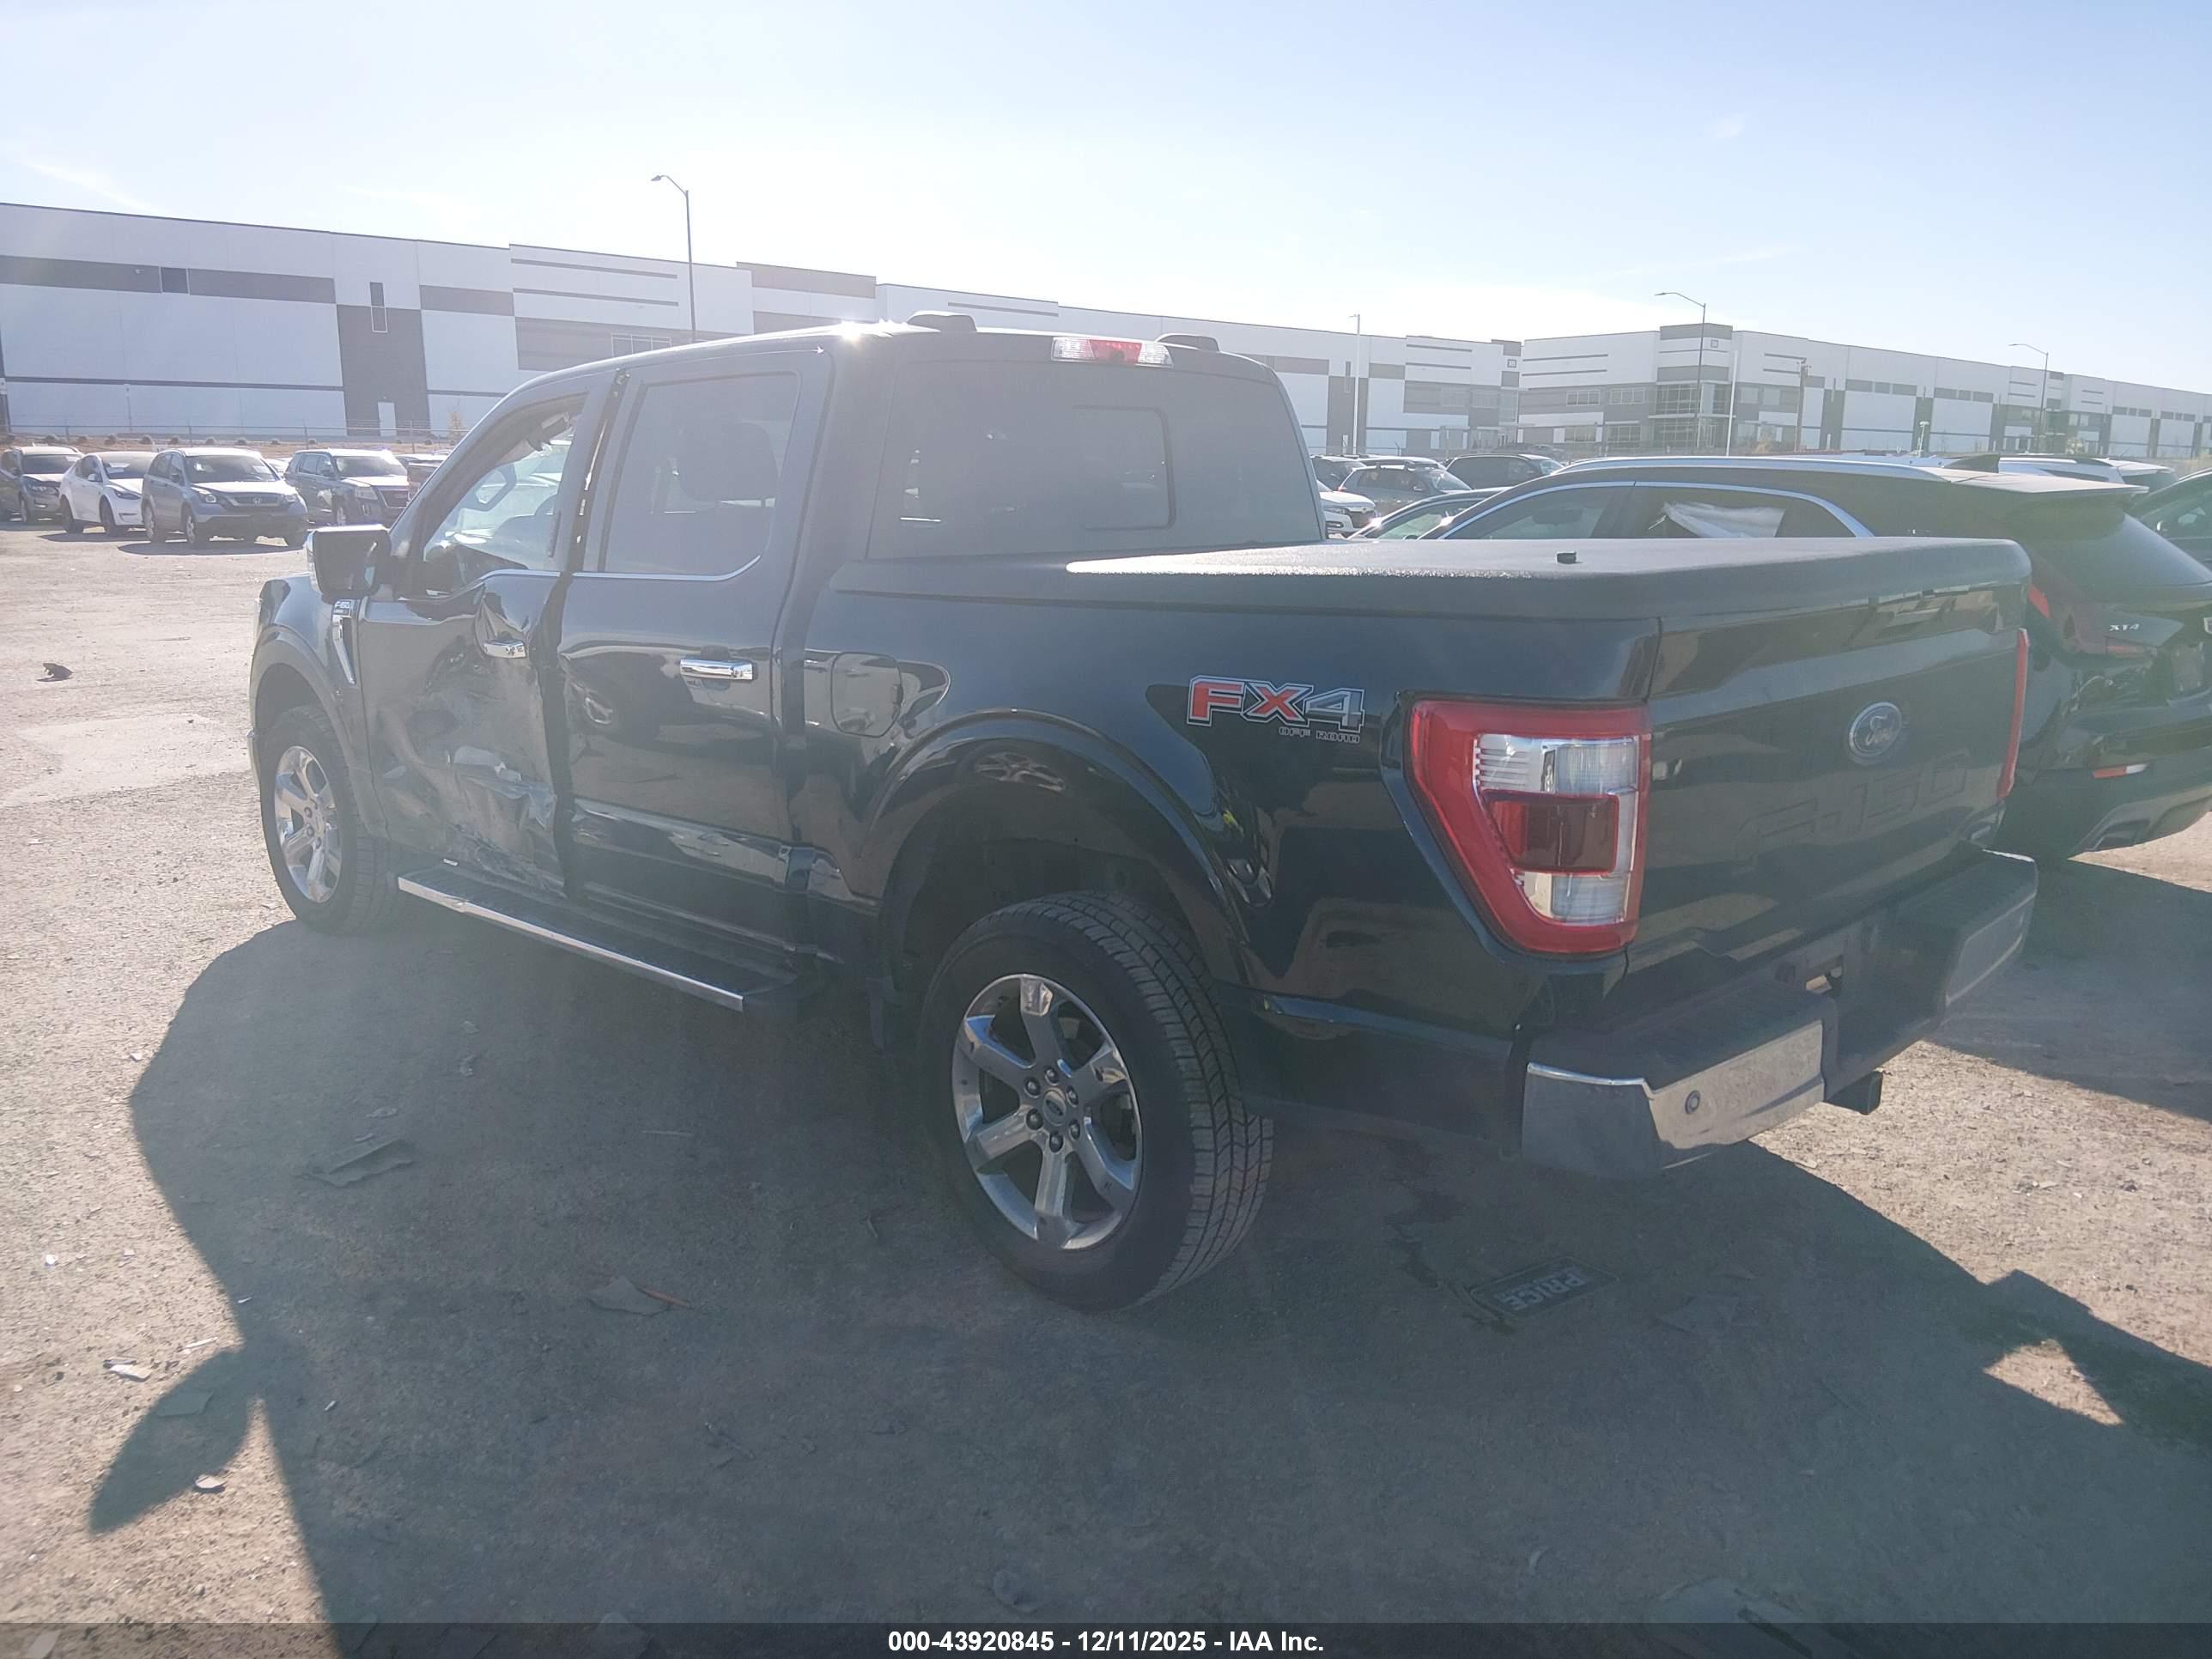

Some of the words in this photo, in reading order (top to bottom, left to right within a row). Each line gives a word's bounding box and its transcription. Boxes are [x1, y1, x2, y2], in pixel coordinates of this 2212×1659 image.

[1187, 675, 1365, 733] FX4
[1279, 726, 1311, 738] OFF
[1316, 730, 1360, 744] ROAD
